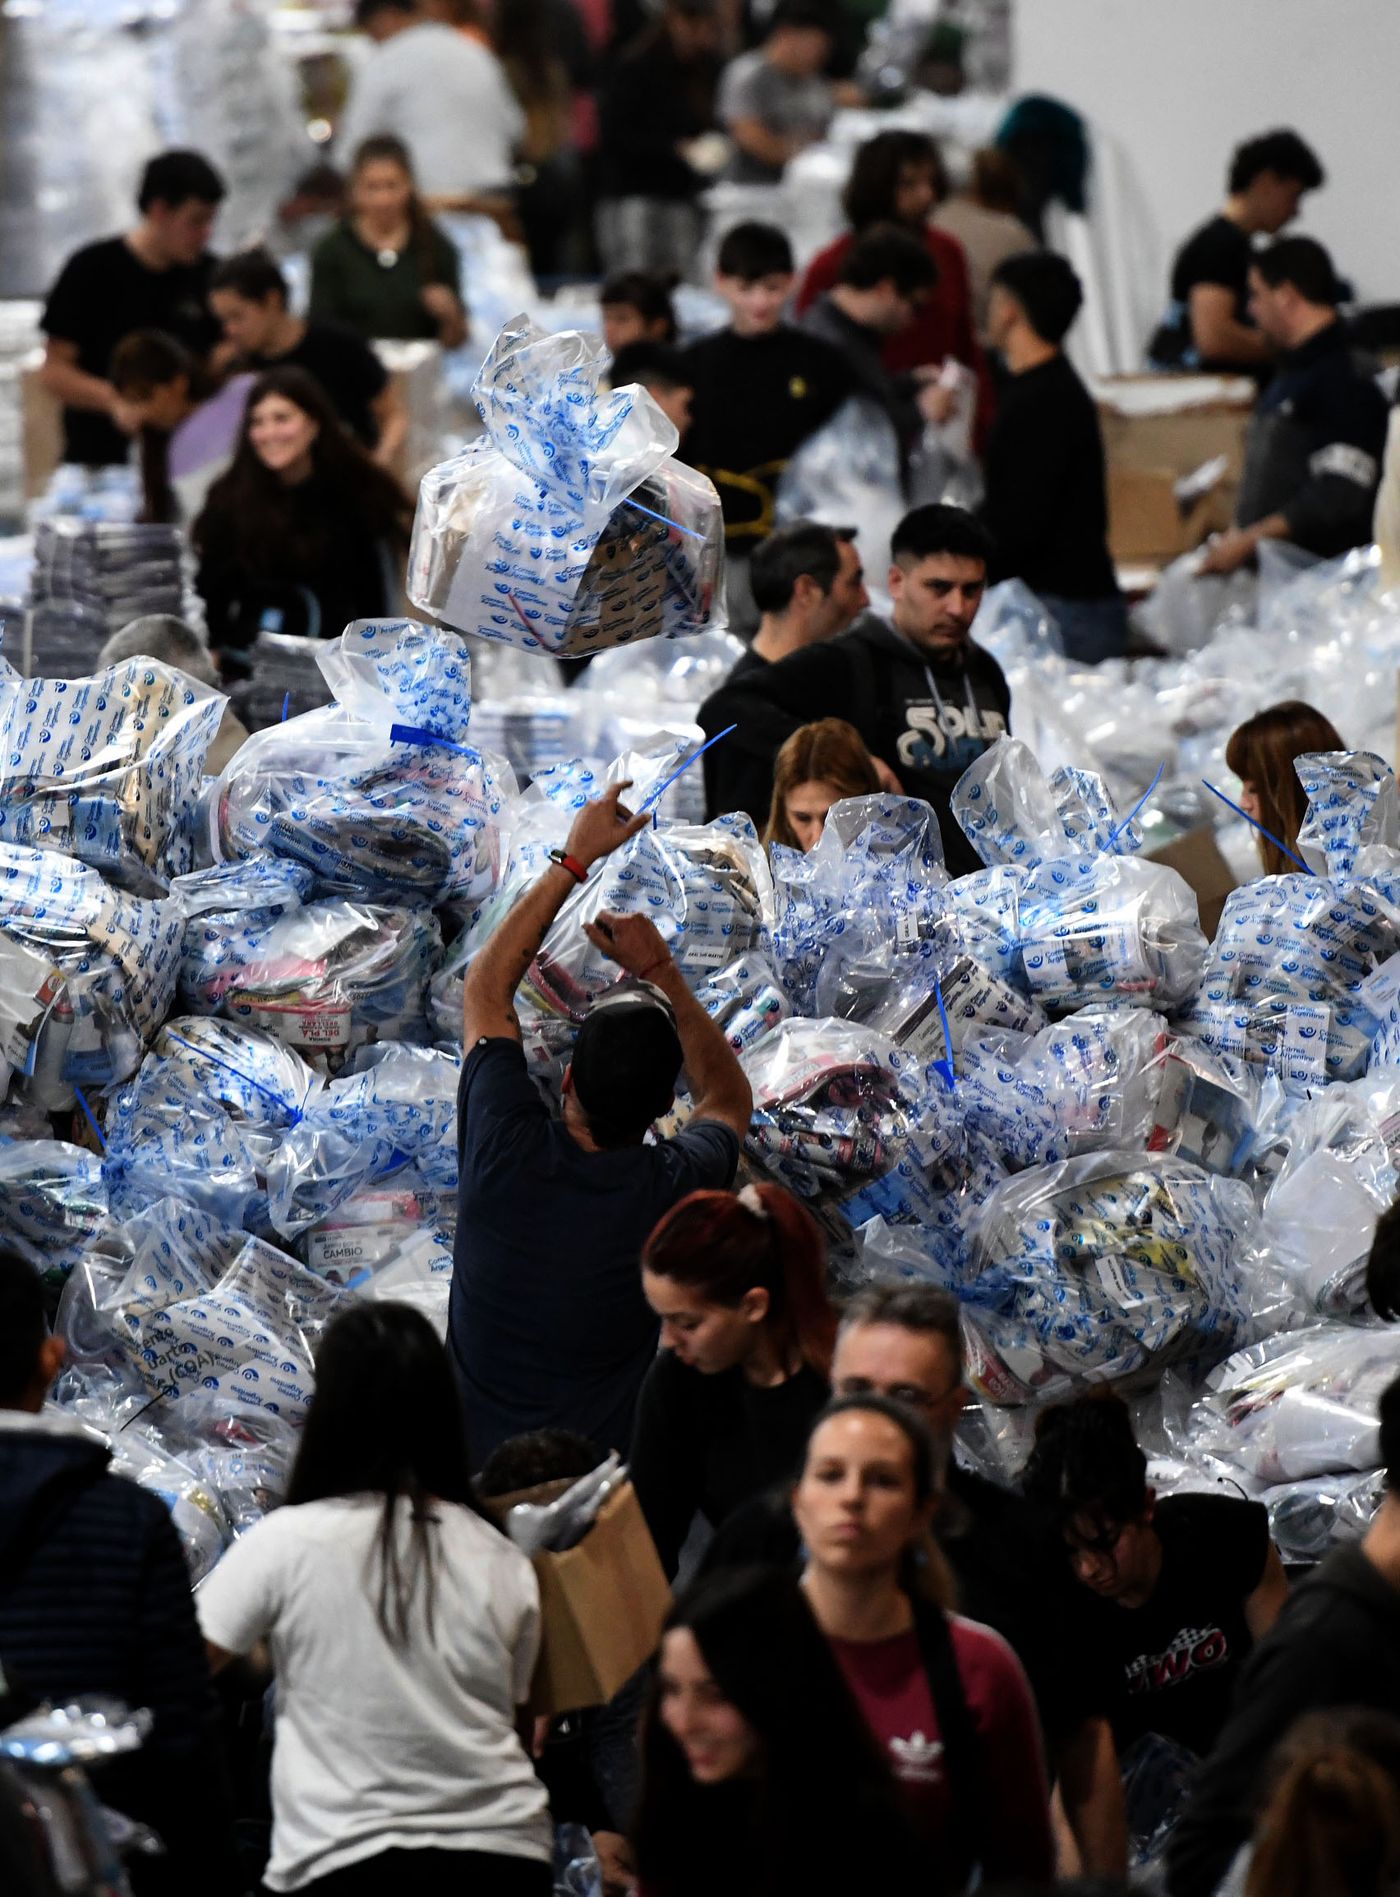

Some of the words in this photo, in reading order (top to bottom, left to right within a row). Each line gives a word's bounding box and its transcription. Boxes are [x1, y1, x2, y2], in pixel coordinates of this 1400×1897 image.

[512, 565, 536, 575] Correo
[514, 587, 538, 598] Correo
[43, 708, 53, 727] Correo
[50, 701, 61, 728] Argentino
[85, 725, 94, 743] Correo
[90, 719, 101, 745] Argentino
[1074, 923, 1109, 934] Argentino
[1275, 936, 1300, 946] Correo
[1046, 948, 1070, 957] Correo
[1275, 942, 1311, 955] Argentino
[1048, 951, 1082, 964] Argentino
[1239, 951, 1262, 960] Correo
[1237, 957, 1271, 968] Argentino
[1264, 977, 1290, 987] Correo
[1263, 985, 1298, 997] Argentino
[1289, 1009, 1325, 1019] Argentino
[1290, 1004, 1316, 1012] Correo
[1319, 1029, 1343, 1038] Correo
[1216, 1036, 1241, 1045] Correo
[1216, 1042, 1251, 1051] Argentino
[1318, 1036, 1353, 1048] Argentino
[1281, 1045, 1305, 1054] Correo
[1280, 1051, 1315, 1062] Argentino
[1016, 1079, 1037, 1091] Correo
[1013, 1084, 1045, 1105] Argentino
[323, 1247, 363, 1259] CAMBIO
[181, 1318, 216, 1337] Argentino
[217, 1317, 250, 1332] Argentino
[191, 1327, 215, 1342] Correo
[227, 1326, 250, 1338] Correo
[244, 1344, 279, 1361] Argentino
[253, 1351, 278, 1368] Correo
[269, 1376, 304, 1395] Argentino
[230, 1385, 263, 1403] Argentino
[278, 1387, 301, 1400] Correo
[238, 1395, 261, 1406] Correo
